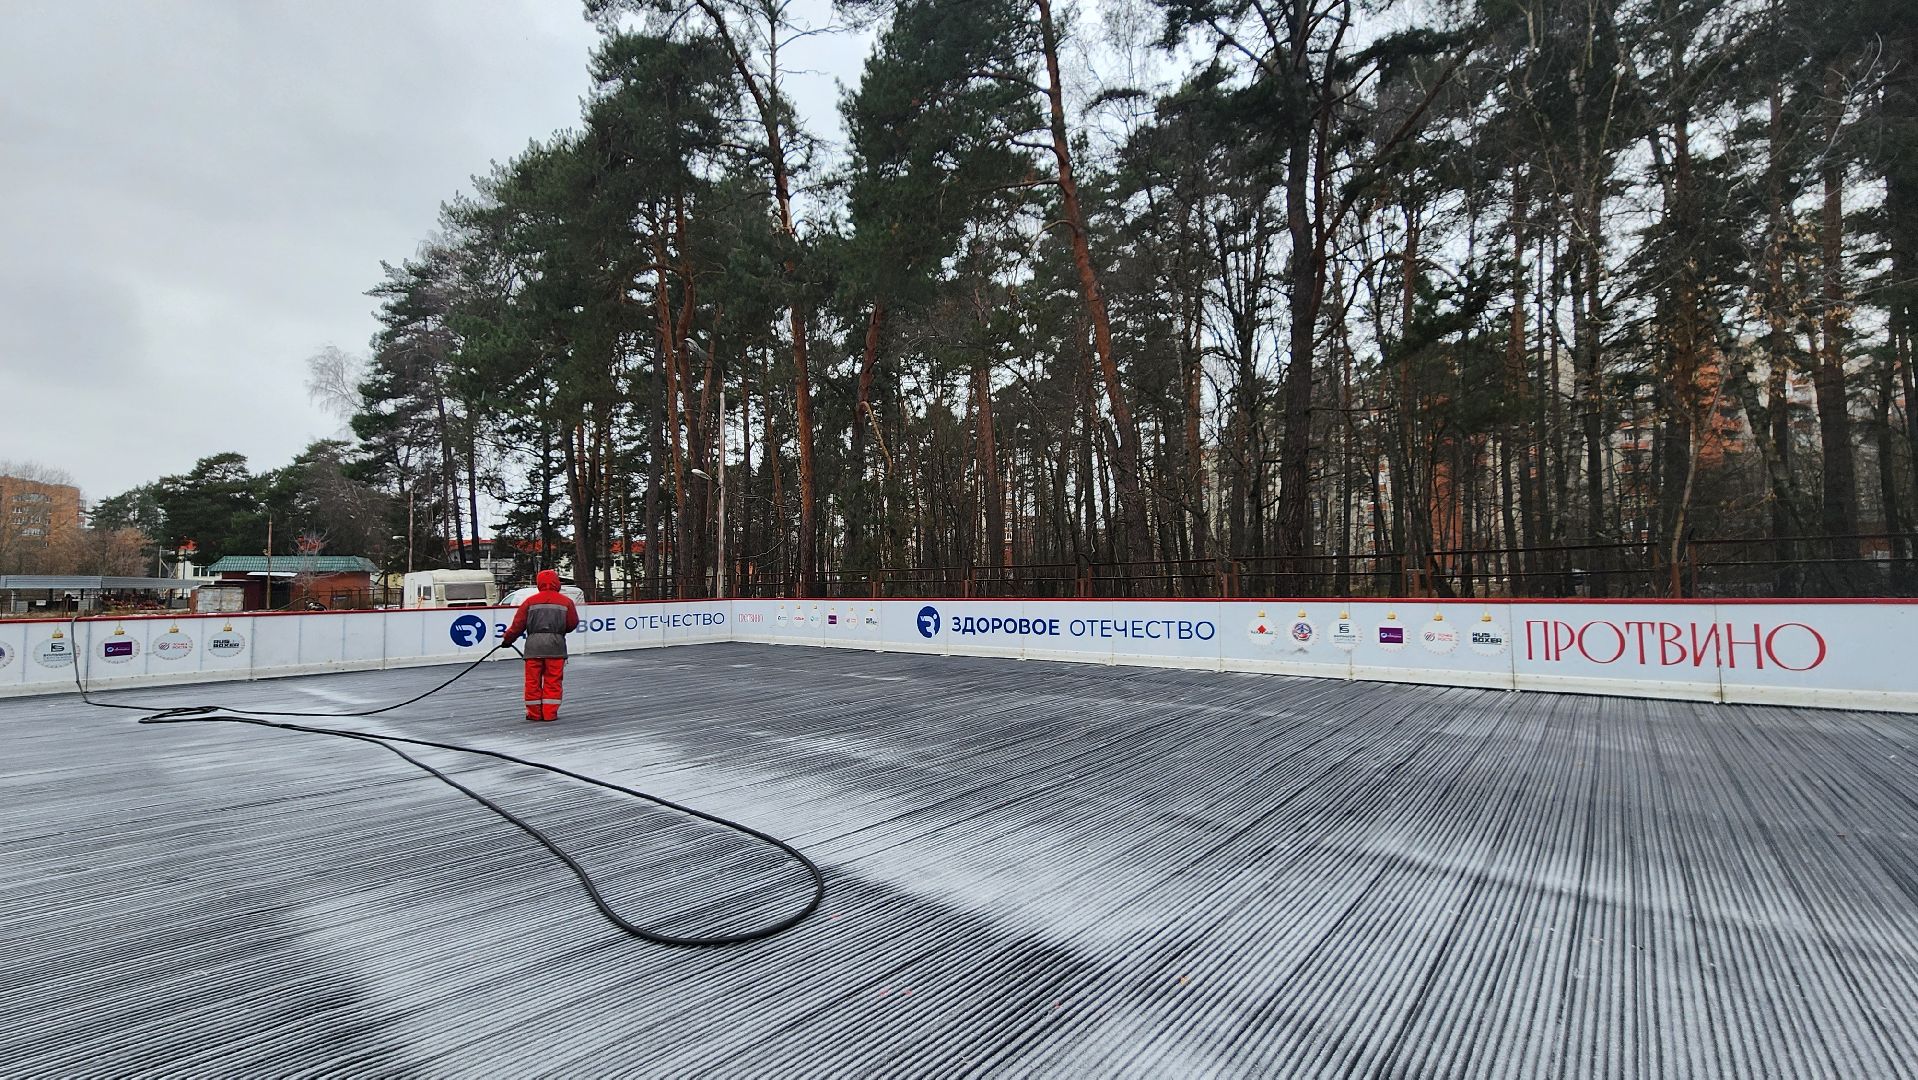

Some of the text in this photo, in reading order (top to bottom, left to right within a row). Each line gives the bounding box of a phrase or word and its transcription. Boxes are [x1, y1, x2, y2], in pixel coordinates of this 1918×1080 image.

[495, 617, 617, 640] ЗВОЕ
[624, 612, 726, 631] ОТЕЧЕСТВО
[951, 616, 1216, 641] ЗДОРОВОЕ ОТЕЧЕСТВО
[1525, 620, 1827, 671] ПРОТВИНО
